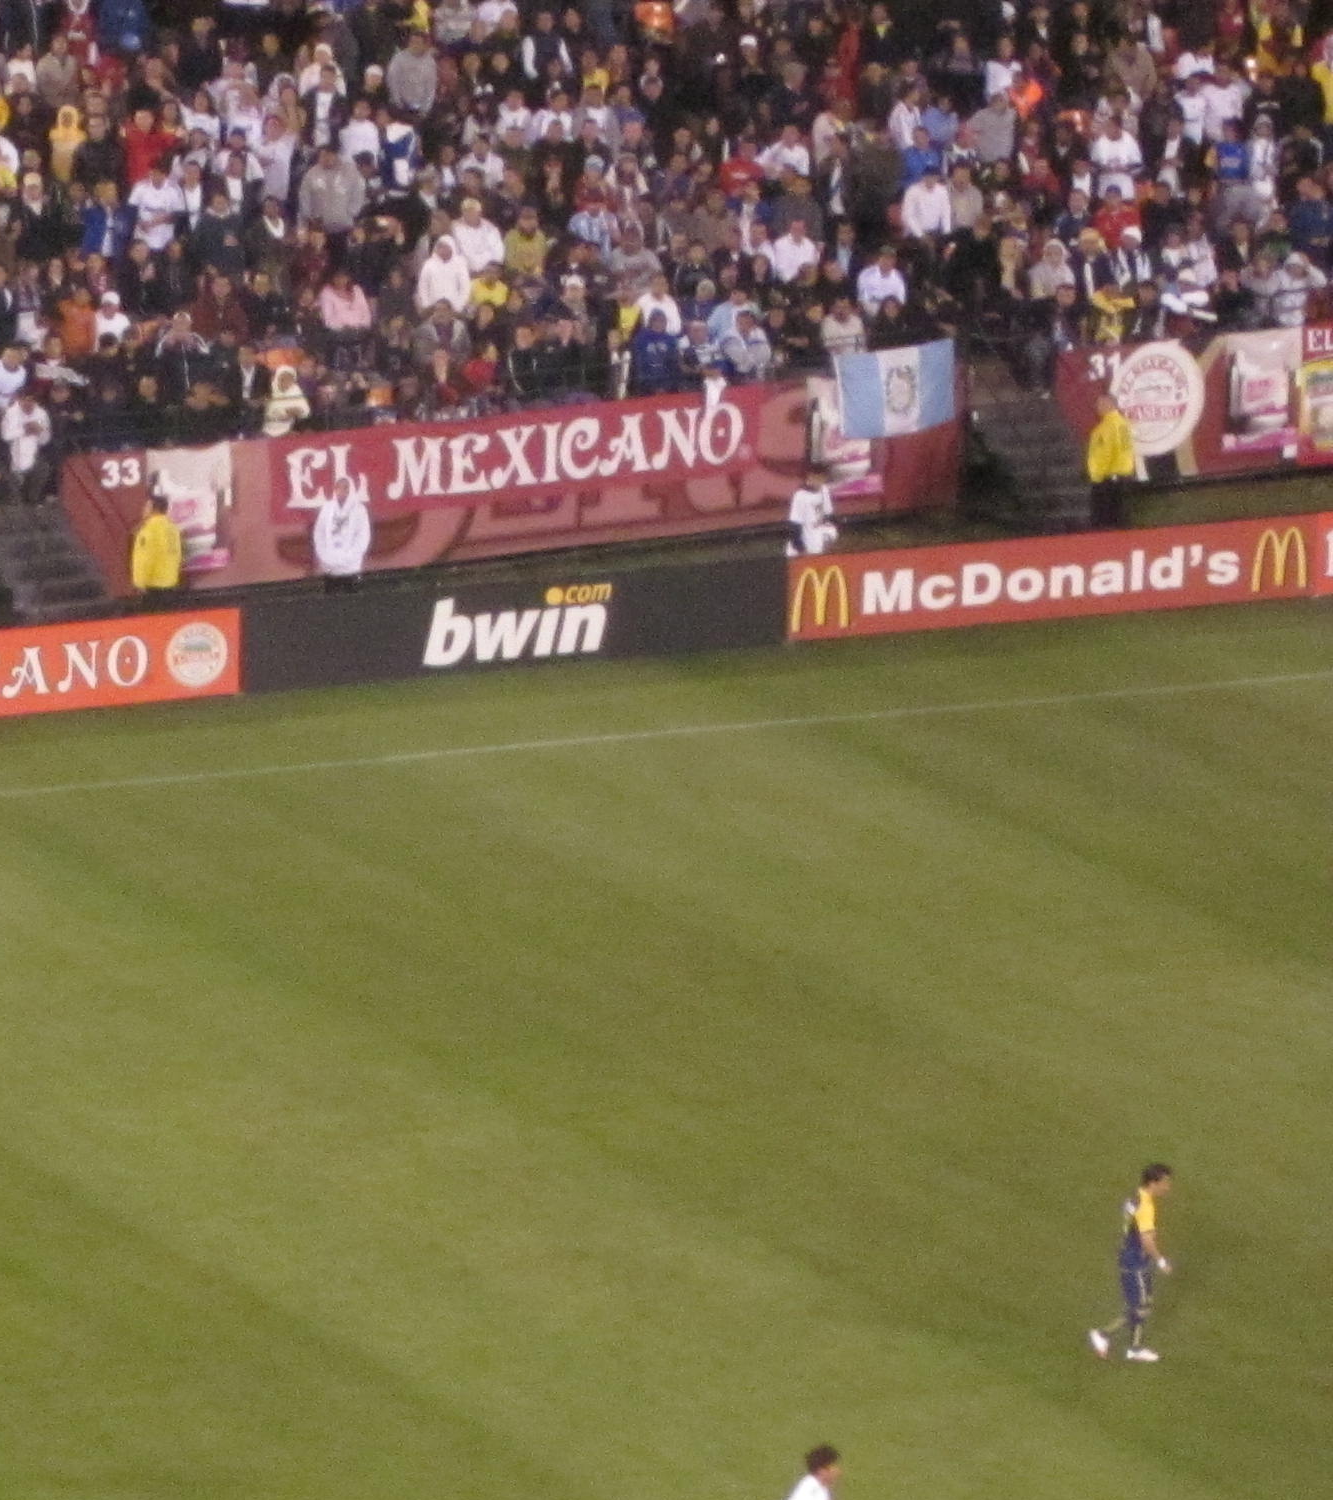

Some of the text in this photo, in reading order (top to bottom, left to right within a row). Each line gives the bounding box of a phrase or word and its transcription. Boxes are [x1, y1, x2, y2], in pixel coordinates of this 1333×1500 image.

[101, 459, 141, 488] 33
[287, 402, 745, 509] EL MEXICANO
[862, 546, 1240, 615] McDonald's
[422, 597, 608, 667] bwin
